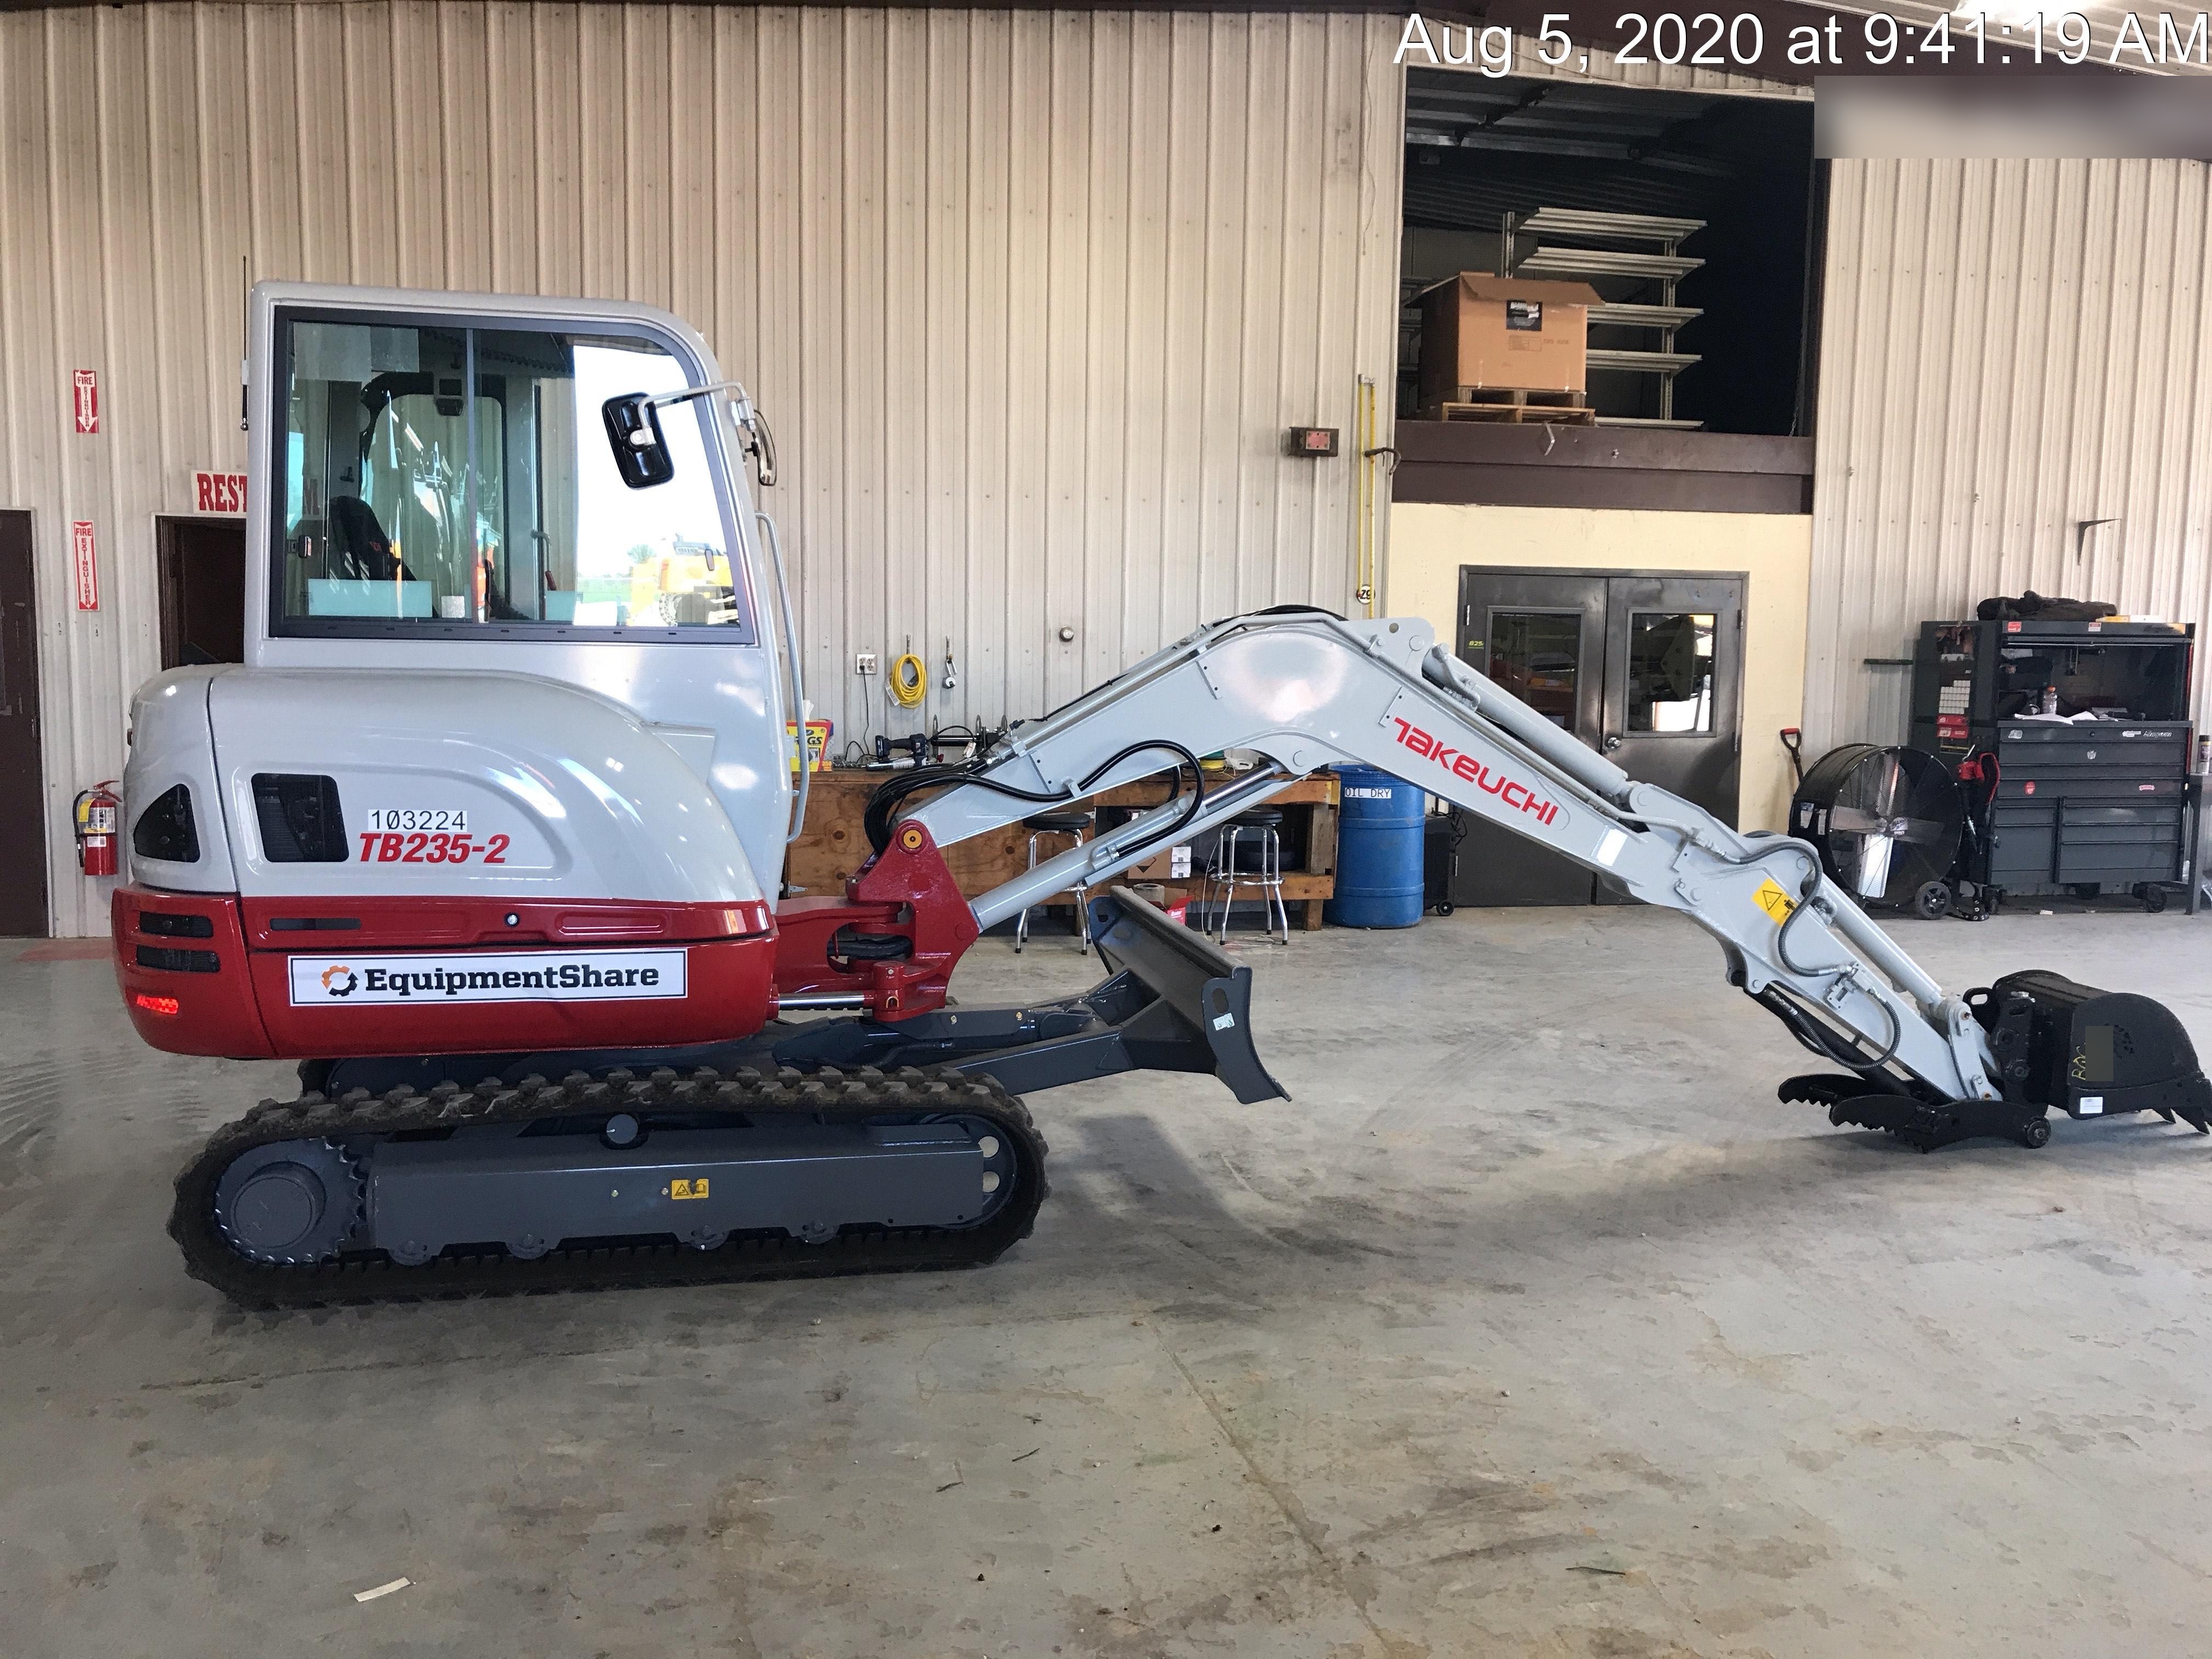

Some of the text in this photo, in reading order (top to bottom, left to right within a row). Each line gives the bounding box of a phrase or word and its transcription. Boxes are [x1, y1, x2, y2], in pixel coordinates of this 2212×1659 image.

[77, 376, 93, 385] FIRE
[76, 528, 92, 536] FIRE
[81, 538, 91, 605] EXTINGUISHER
[1345, 788, 1390, 798] OIL DRY
[371, 809, 466, 830] 103224
[359, 832, 511, 864] TB235-2
[364, 964, 659, 996] EquipmentShare
